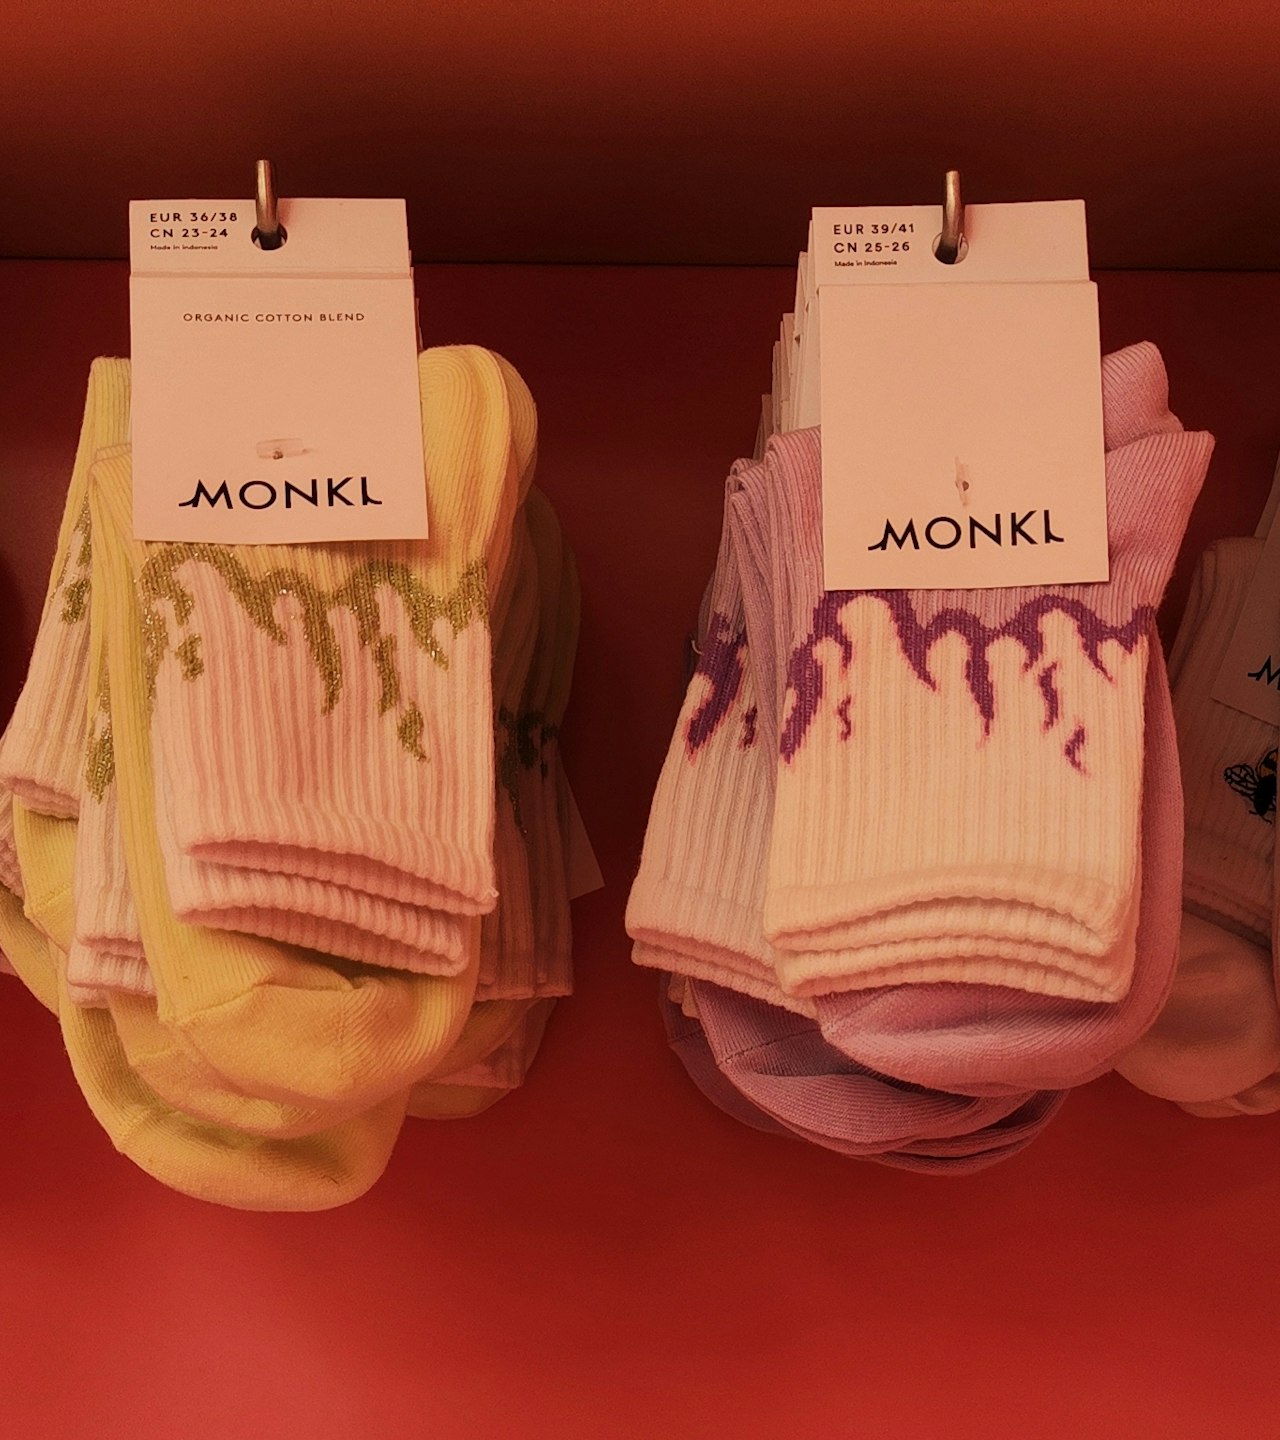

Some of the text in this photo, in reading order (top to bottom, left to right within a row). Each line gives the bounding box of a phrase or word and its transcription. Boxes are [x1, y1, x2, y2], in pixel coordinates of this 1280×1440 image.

[150, 211, 238, 223] EUR 36/38
[150, 228, 228, 238] CN 23-24
[833, 223, 915, 235] EUR 39/41
[833, 241, 910, 253] CN 25-26
[183, 312, 365, 323] ORGANIC COTTON BLEND
